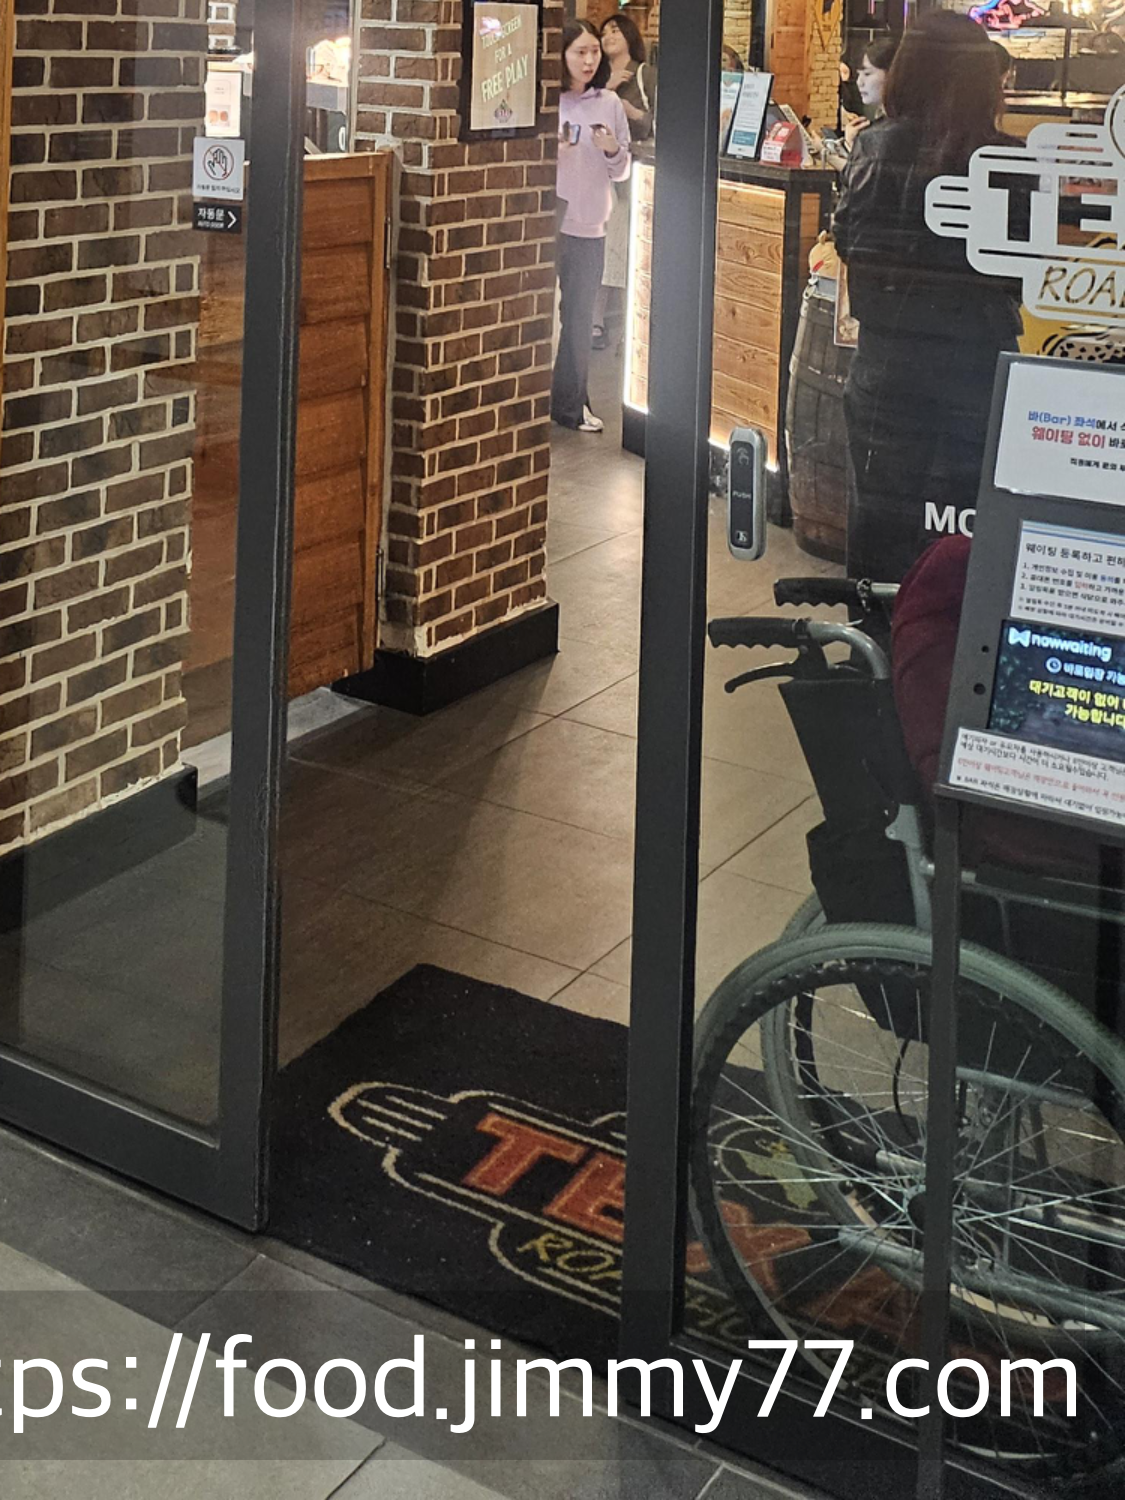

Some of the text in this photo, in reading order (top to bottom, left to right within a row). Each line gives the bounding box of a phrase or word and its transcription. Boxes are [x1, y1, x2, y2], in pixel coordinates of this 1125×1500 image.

[481, 53, 529, 103] FREE PLAY
[197, 207, 225, 221] 자동문
[988, 170, 1125, 250] TE
[1038, 265, 1125, 309] ROA
[1028, 410, 1072, 426] 바(Bar)
[1073, 416, 1118, 431] 좌석에서
[1032, 426, 1074, 445] 웨이팅
[1078, 431, 1107, 449] 없이
[1026, 543, 1057, 557] 웨이팅
[1060, 547, 1103, 563] 등록하고
[1032, 563, 1058, 574] 개인정보
[1030, 574, 1050, 584] 휴대폰
[1052, 578, 1072, 587] 번호를
[1031, 633, 1112, 662] nowwaiting
[1063, 662, 1105, 681] 바로입장
[1029, 680, 1091, 704] 대기고객이
